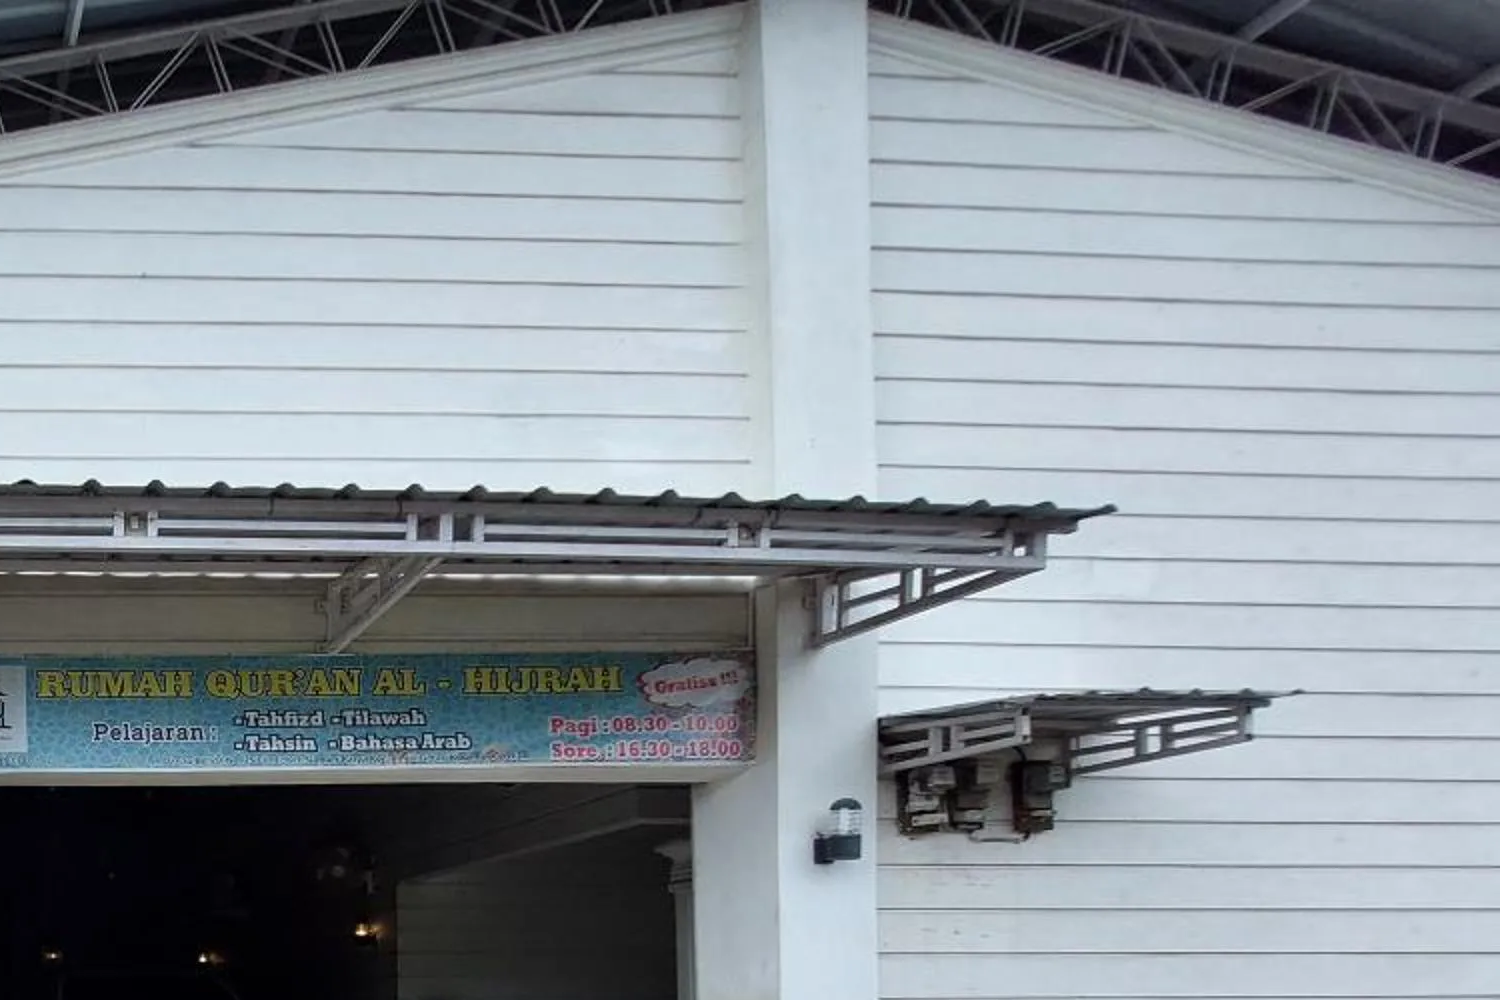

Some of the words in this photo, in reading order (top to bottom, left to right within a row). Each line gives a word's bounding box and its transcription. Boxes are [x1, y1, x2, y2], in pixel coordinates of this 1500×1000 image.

[36, 669, 193, 698] RUMAH
[373, 667, 426, 697] AL
[462, 665, 623, 694] HIJRAH
[93, 722, 204, 744] Pelajaran
[550, 717, 598, 738] Pagi
[421, 732, 472, 750] Arab
